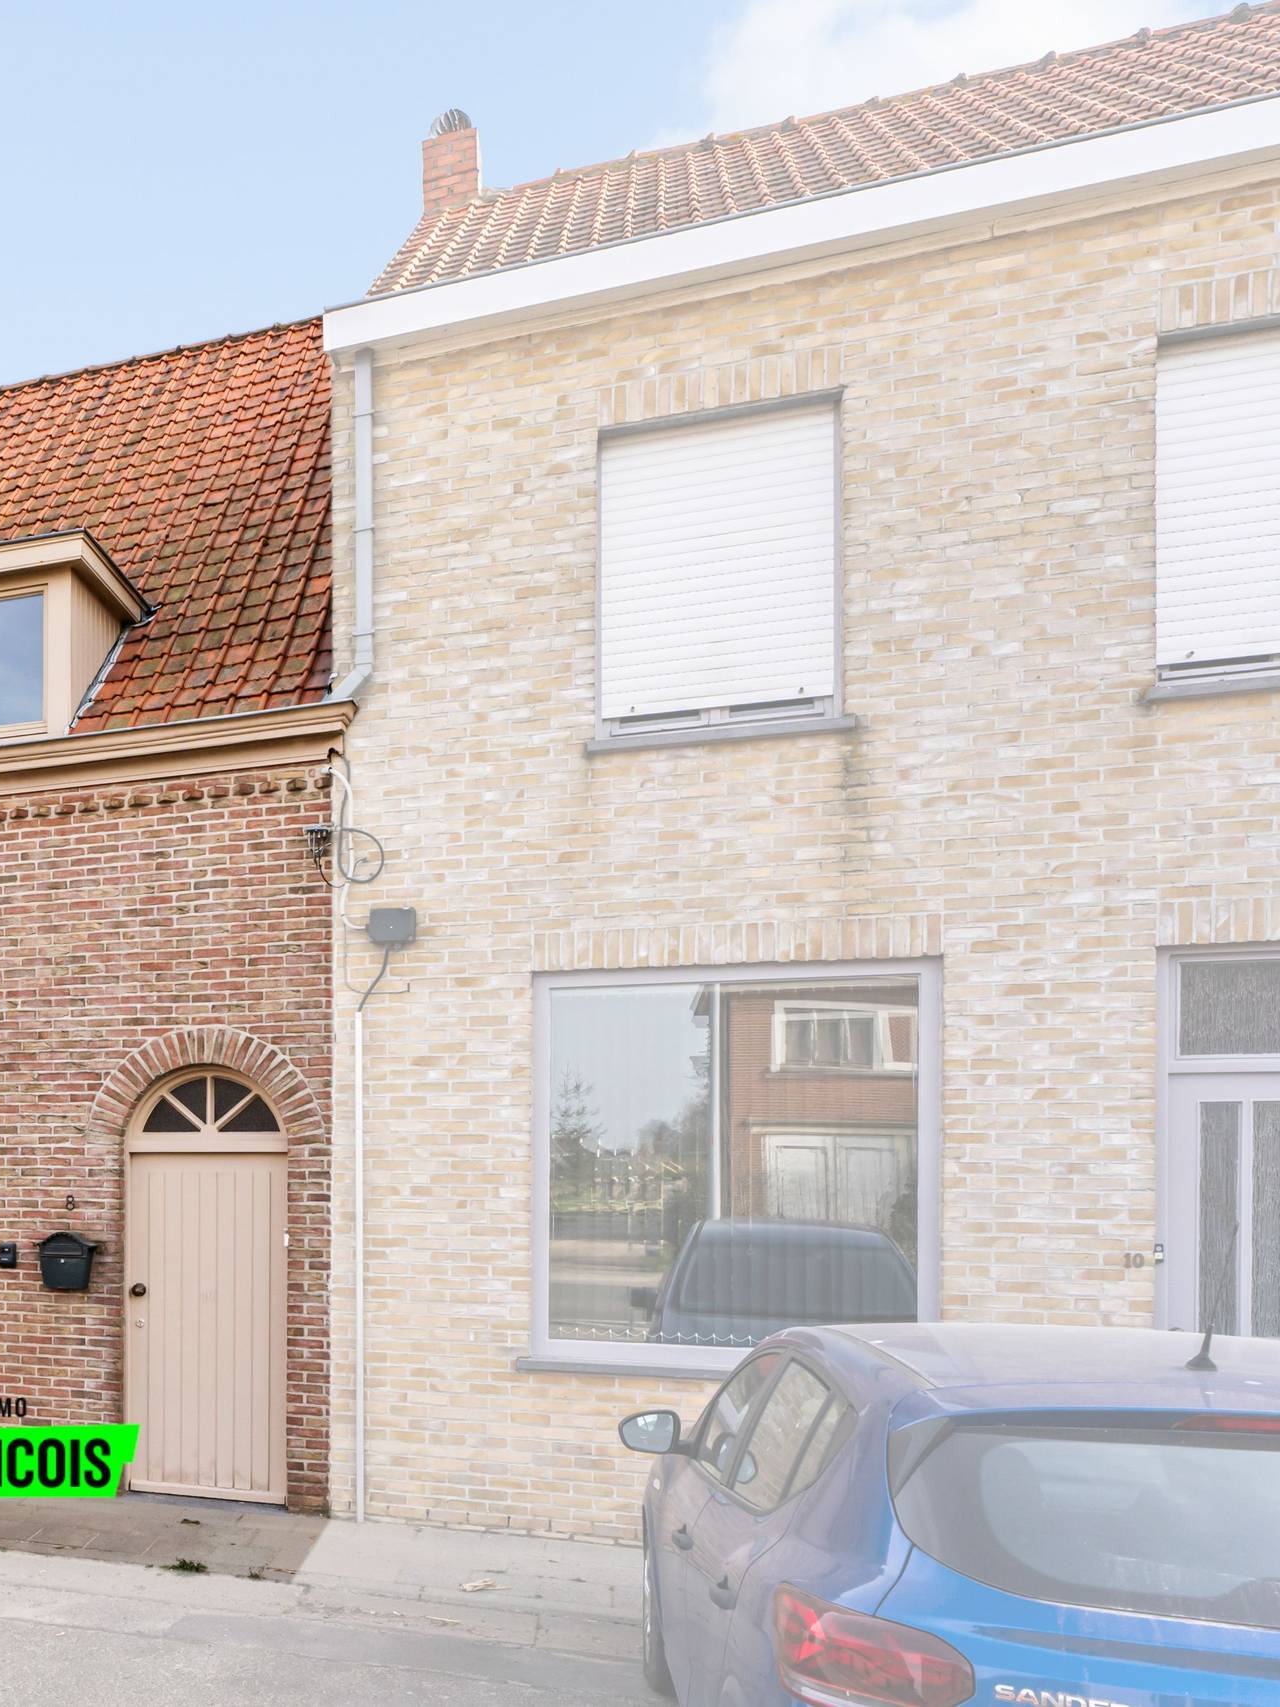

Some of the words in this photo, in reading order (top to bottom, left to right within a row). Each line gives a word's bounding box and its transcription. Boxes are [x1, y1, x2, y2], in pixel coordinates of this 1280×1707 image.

[66, 1195, 75, 1211] 8
[1123, 1252, 1145, 1269] 10
[994, 1684, 1131, 1707] SAND
